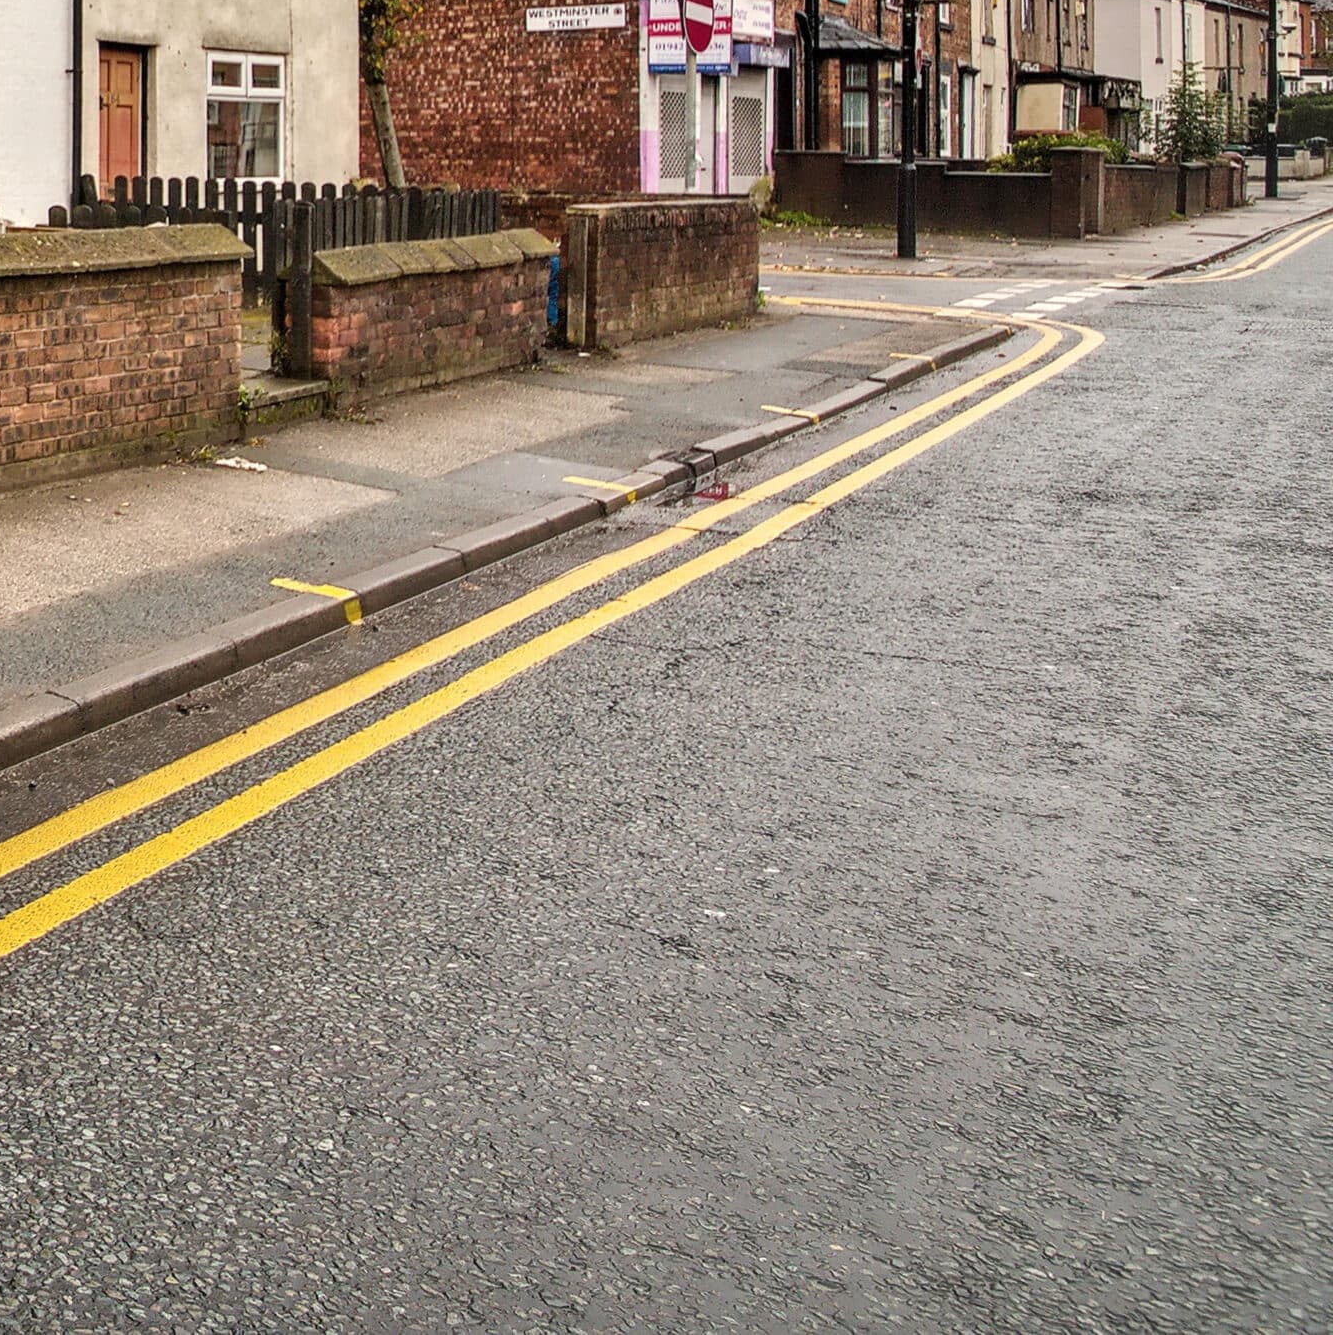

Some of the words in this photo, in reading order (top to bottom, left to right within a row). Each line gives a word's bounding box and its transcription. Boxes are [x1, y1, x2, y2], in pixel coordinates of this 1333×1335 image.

[528, 7, 609, 18] WESTMINSTER
[548, 19, 590, 28] STREET
[652, 22, 681, 32] UNDE
